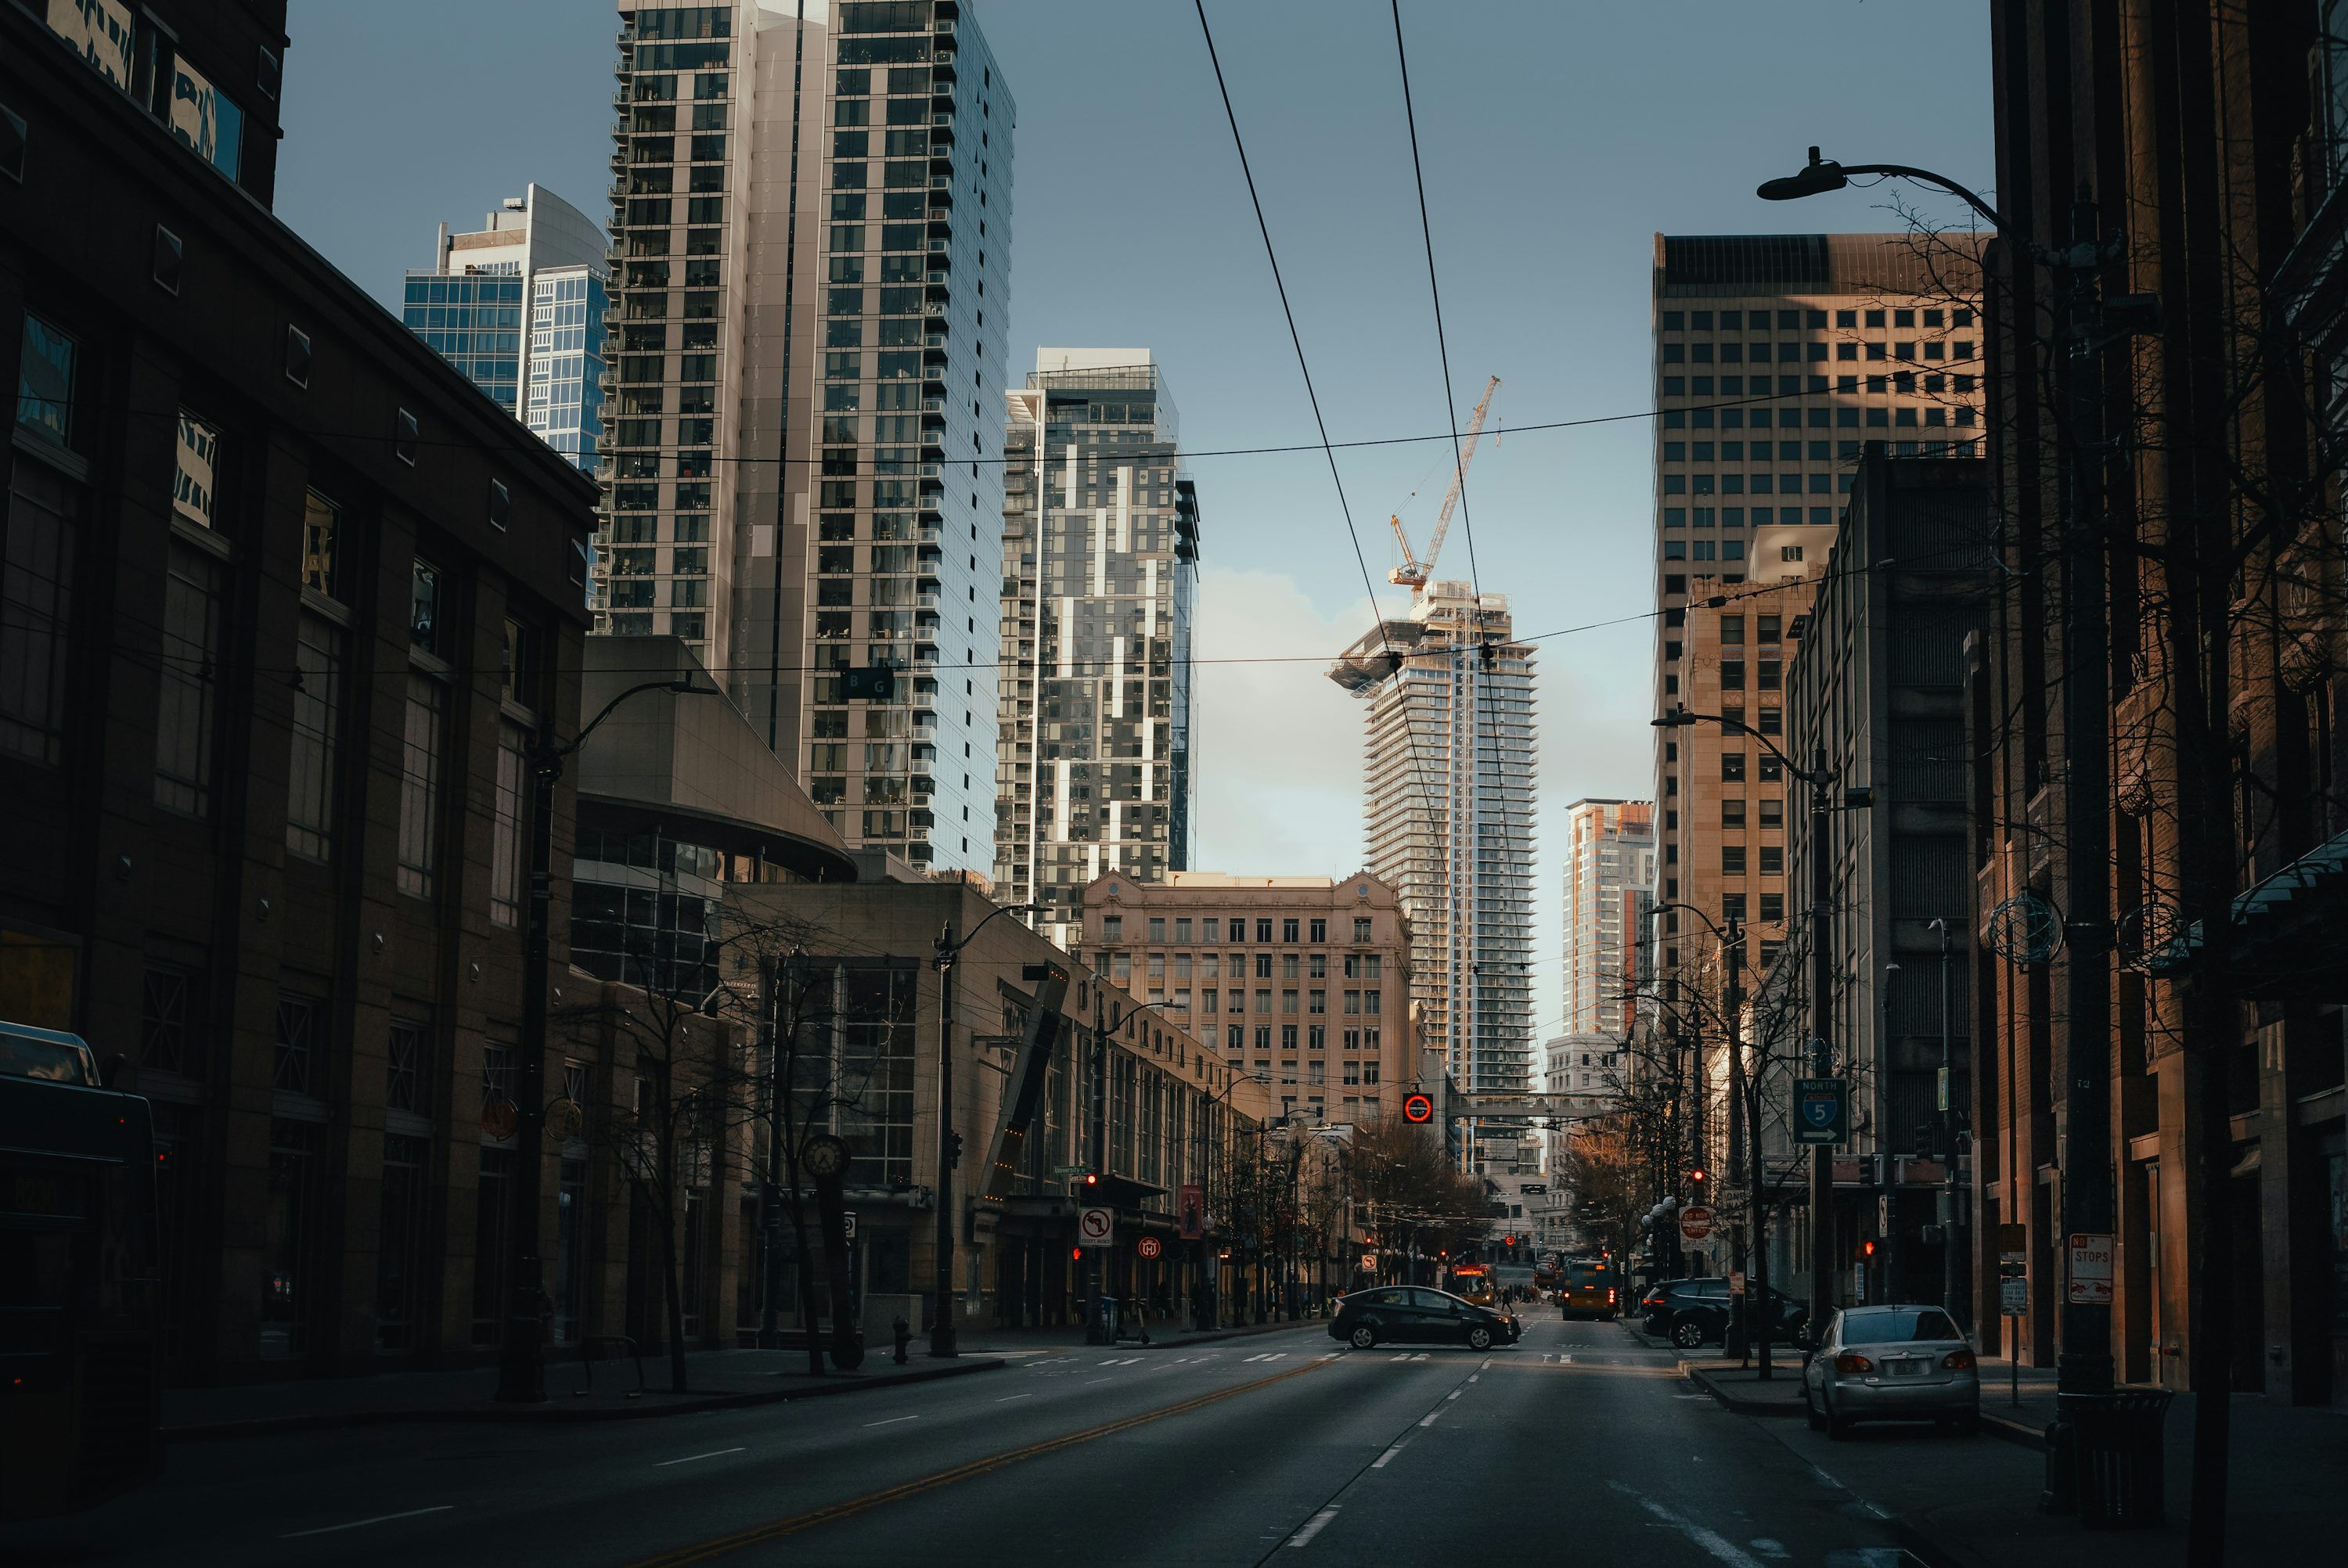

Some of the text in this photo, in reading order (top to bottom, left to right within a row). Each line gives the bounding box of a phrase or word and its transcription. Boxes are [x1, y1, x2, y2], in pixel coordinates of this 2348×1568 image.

[850, 675, 859, 687] B
[874, 681, 884, 692] G
[1815, 1104, 1825, 1120] 5
[2073, 1237, 2085, 1246] NO
[2076, 1251, 2109, 1263] STOPS
